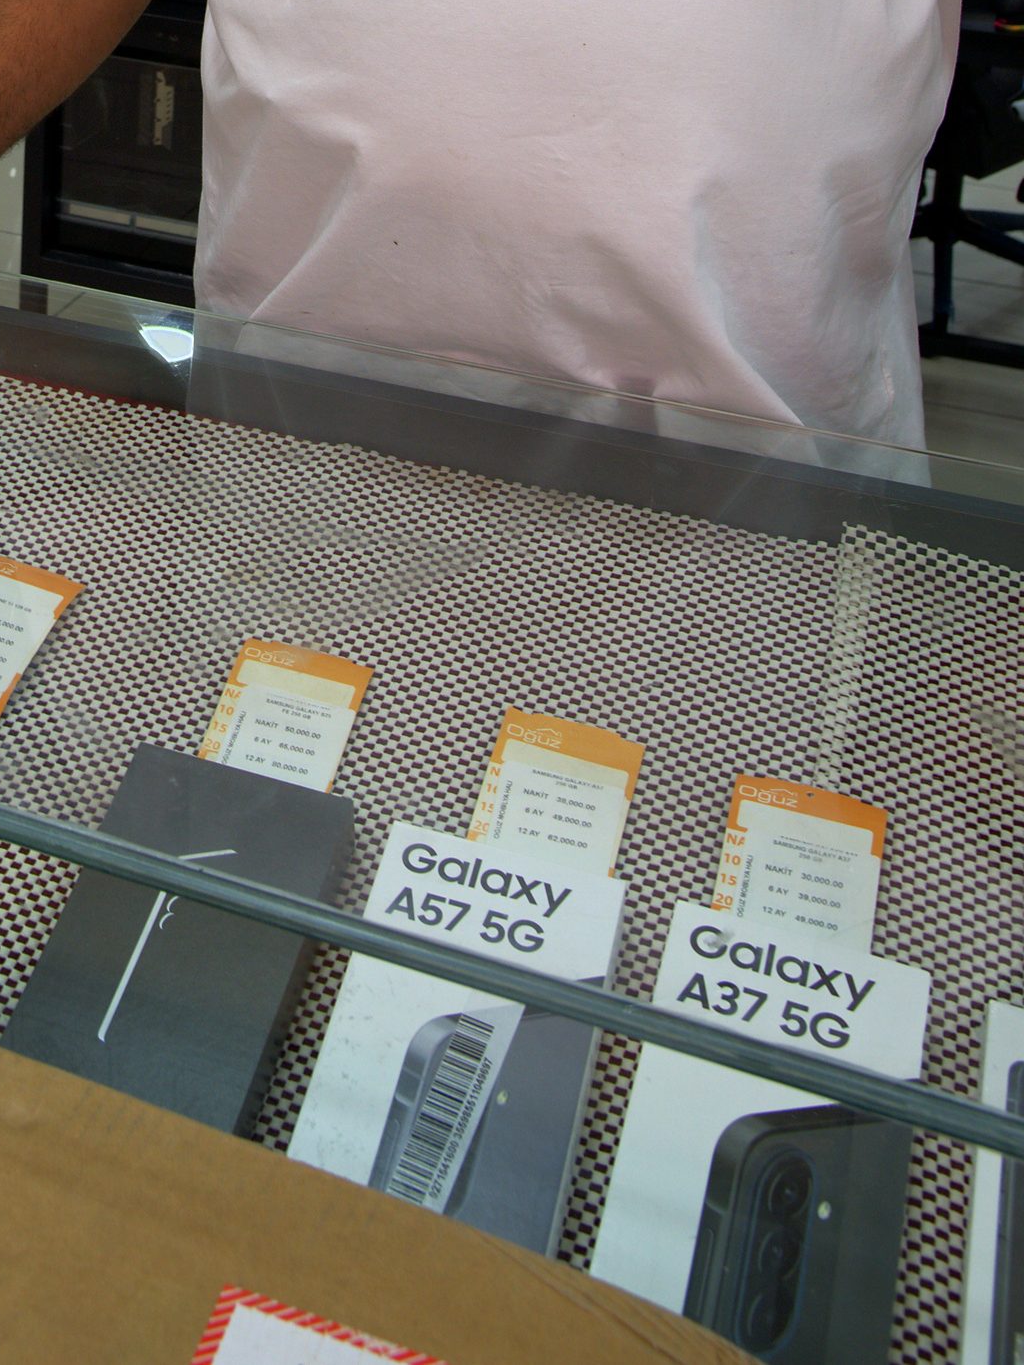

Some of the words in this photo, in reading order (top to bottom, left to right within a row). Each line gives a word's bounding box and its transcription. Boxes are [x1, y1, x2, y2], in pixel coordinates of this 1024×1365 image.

[245, 647, 295, 667] Oğuz
[219, 704, 234, 716] 10
[266, 698, 294, 710] SAMSUNG
[213, 720, 228, 733] 15
[261, 738, 272, 746] AY
[507, 723, 562, 749] Oğuz
[205, 738, 221, 750] 20
[245, 753, 254, 762] 12
[255, 756, 266, 765] AY
[523, 787, 549, 800] NAKİT
[739, 785, 799, 808] Oğuz
[532, 809, 545, 817] AY
[518, 827, 528, 835] 12
[529, 829, 541, 837] AY
[773, 839, 806, 853] SAMSUNG
[808, 848, 836, 859] GALAXY
[724, 853, 741, 866] 10
[765, 863, 793, 877] NAKİT
[401, 842, 573, 918] Galaxy
[720, 873, 737, 886] 15
[776, 887, 789, 896] AY
[715, 893, 733, 906] 20
[762, 906, 773, 915] 12
[774, 908, 787, 917] AY
[385, 886, 471, 933] A57
[479, 911, 545, 954] 5G
[688, 924, 875, 1012] Galaxy
[676, 973, 768, 1023] A37
[779, 1004, 851, 1050] 5G
